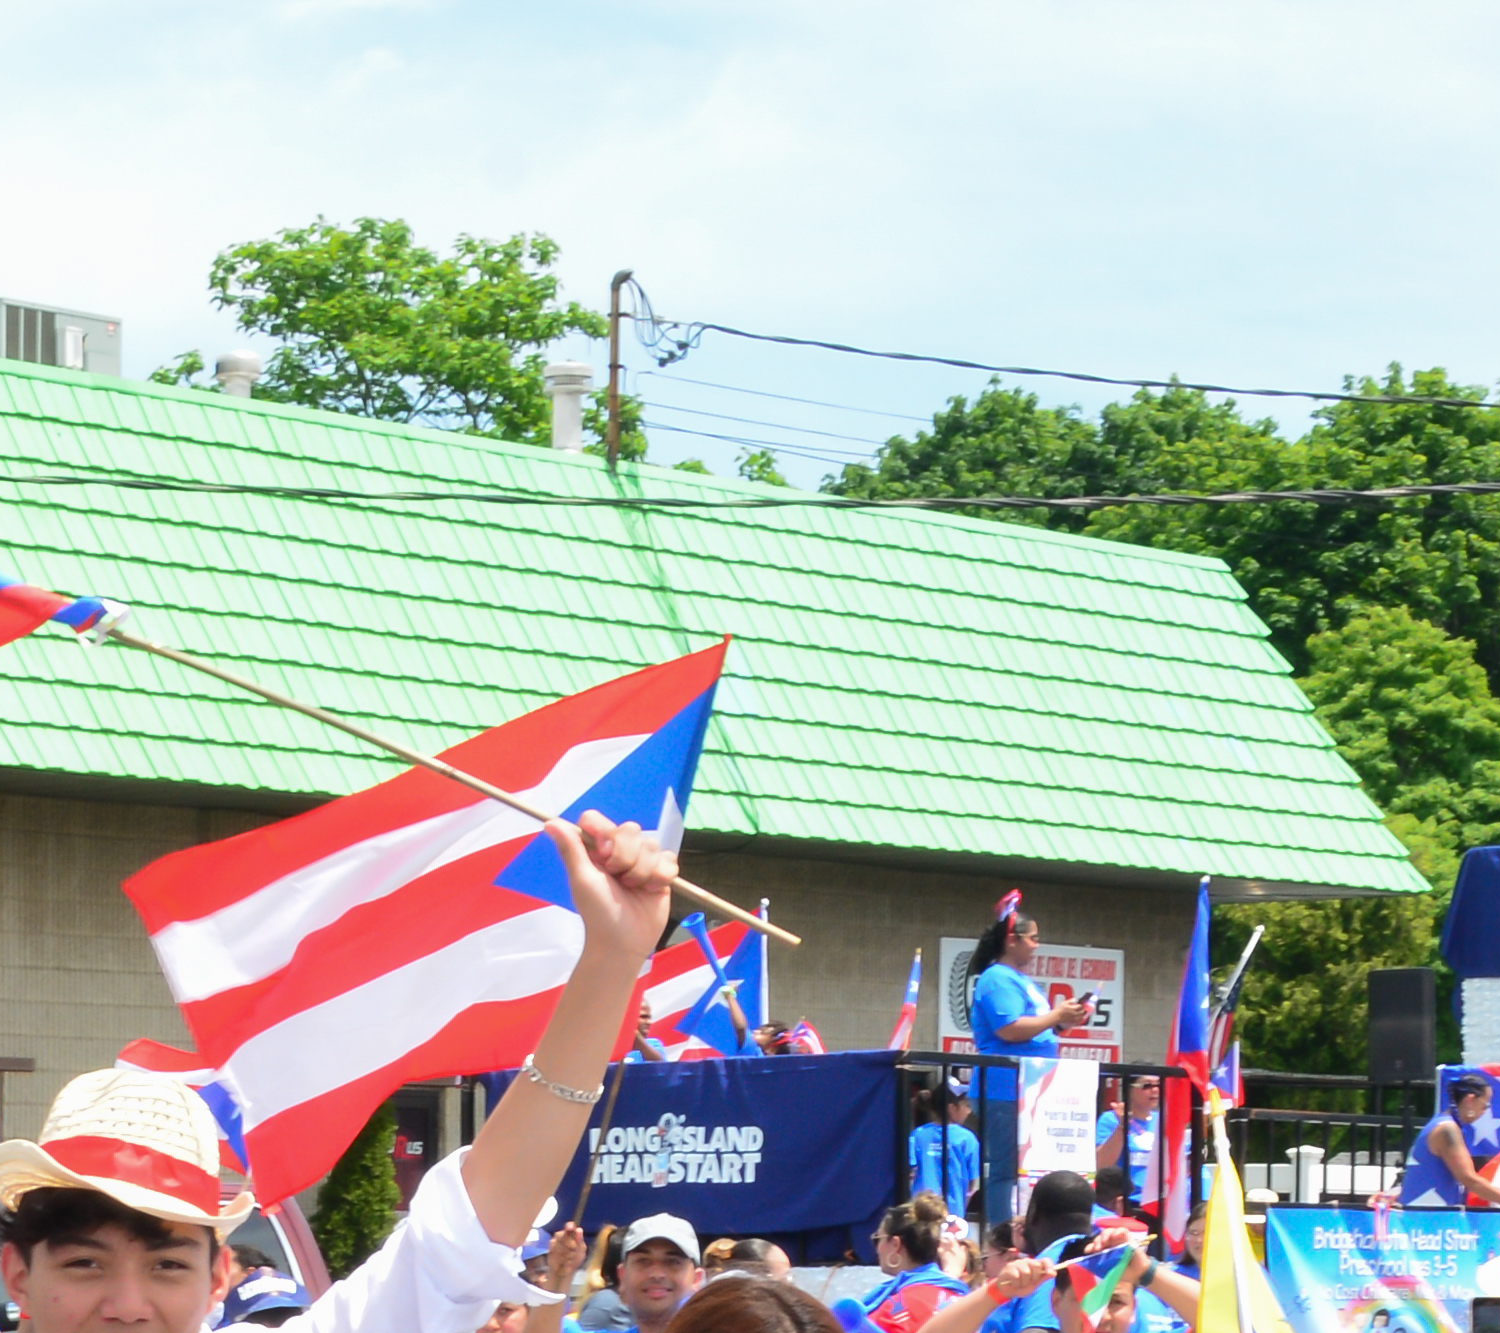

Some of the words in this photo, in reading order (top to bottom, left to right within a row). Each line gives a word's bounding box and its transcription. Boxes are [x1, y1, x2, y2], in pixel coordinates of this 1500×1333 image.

[589, 1126, 660, 1153] LONG
[590, 1153, 658, 1184] HEAD
[668, 1152, 762, 1184] START
